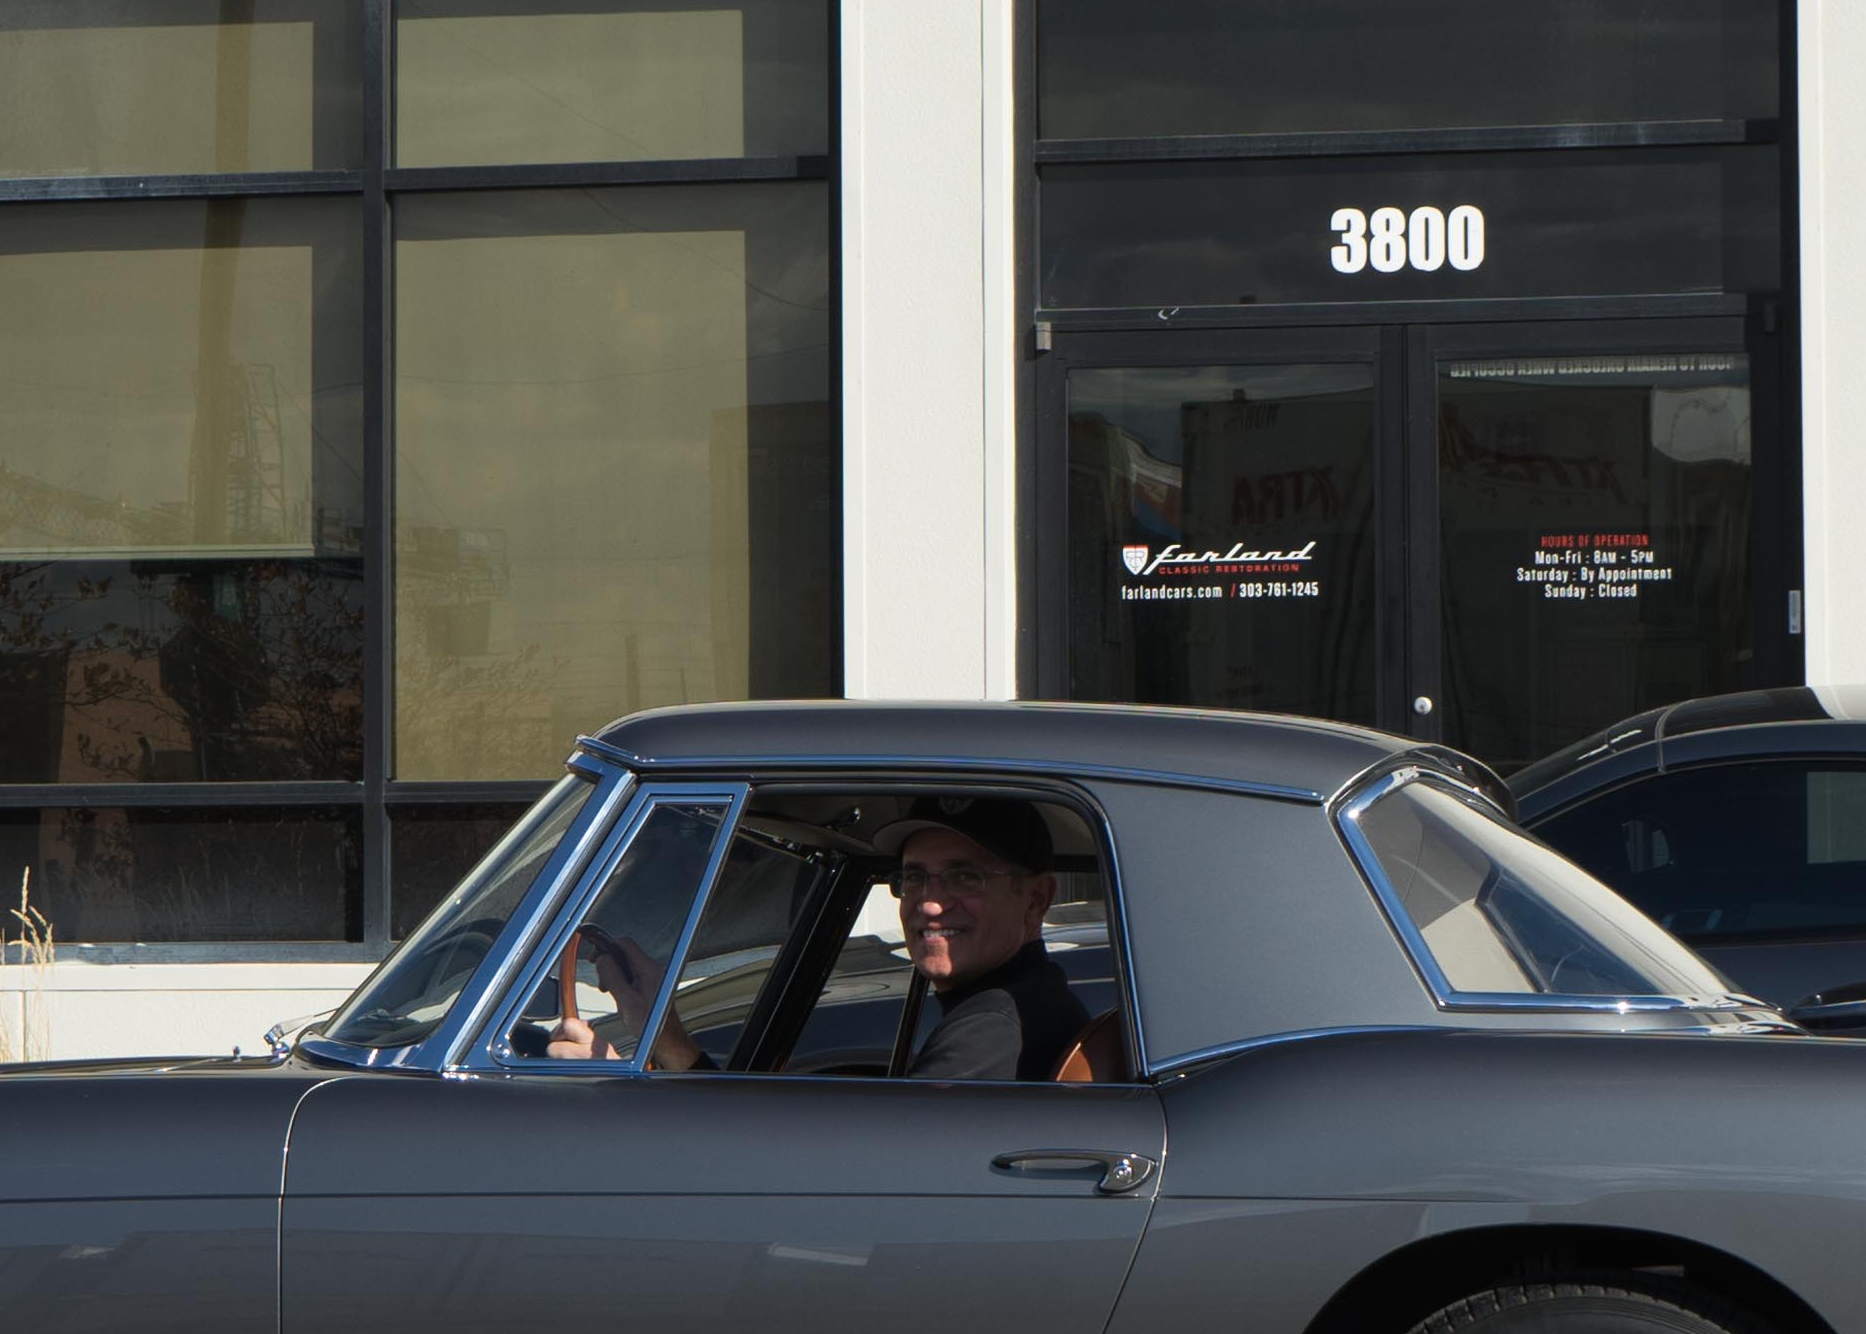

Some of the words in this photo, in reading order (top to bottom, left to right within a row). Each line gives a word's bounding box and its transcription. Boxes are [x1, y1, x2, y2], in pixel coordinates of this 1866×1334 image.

[1330, 205, 1485, 273] 3800
[1541, 536, 1574, 548] HOURS
[1578, 535, 1590, 548] OF
[1595, 534, 1648, 547] OPERATION
[1141, 541, 1317, 575] farland
[1535, 550, 1582, 564] Mon-Fri
[1594, 550, 1617, 564] 8AM
[1631, 550, 1654, 564] 5PM
[1159, 565, 1210, 576] CLASSIC
[1216, 563, 1300, 573] RESTORATION
[1517, 568, 1569, 583] Saturday
[1581, 567, 1595, 583] By
[1598, 567, 1672, 583] Appointment
[1122, 584, 1223, 600] farlandcars.com
[1239, 582, 1319, 598] 303-761-1245
[1544, 584, 1586, 600] Sunday
[1598, 584, 1637, 598] Closed
